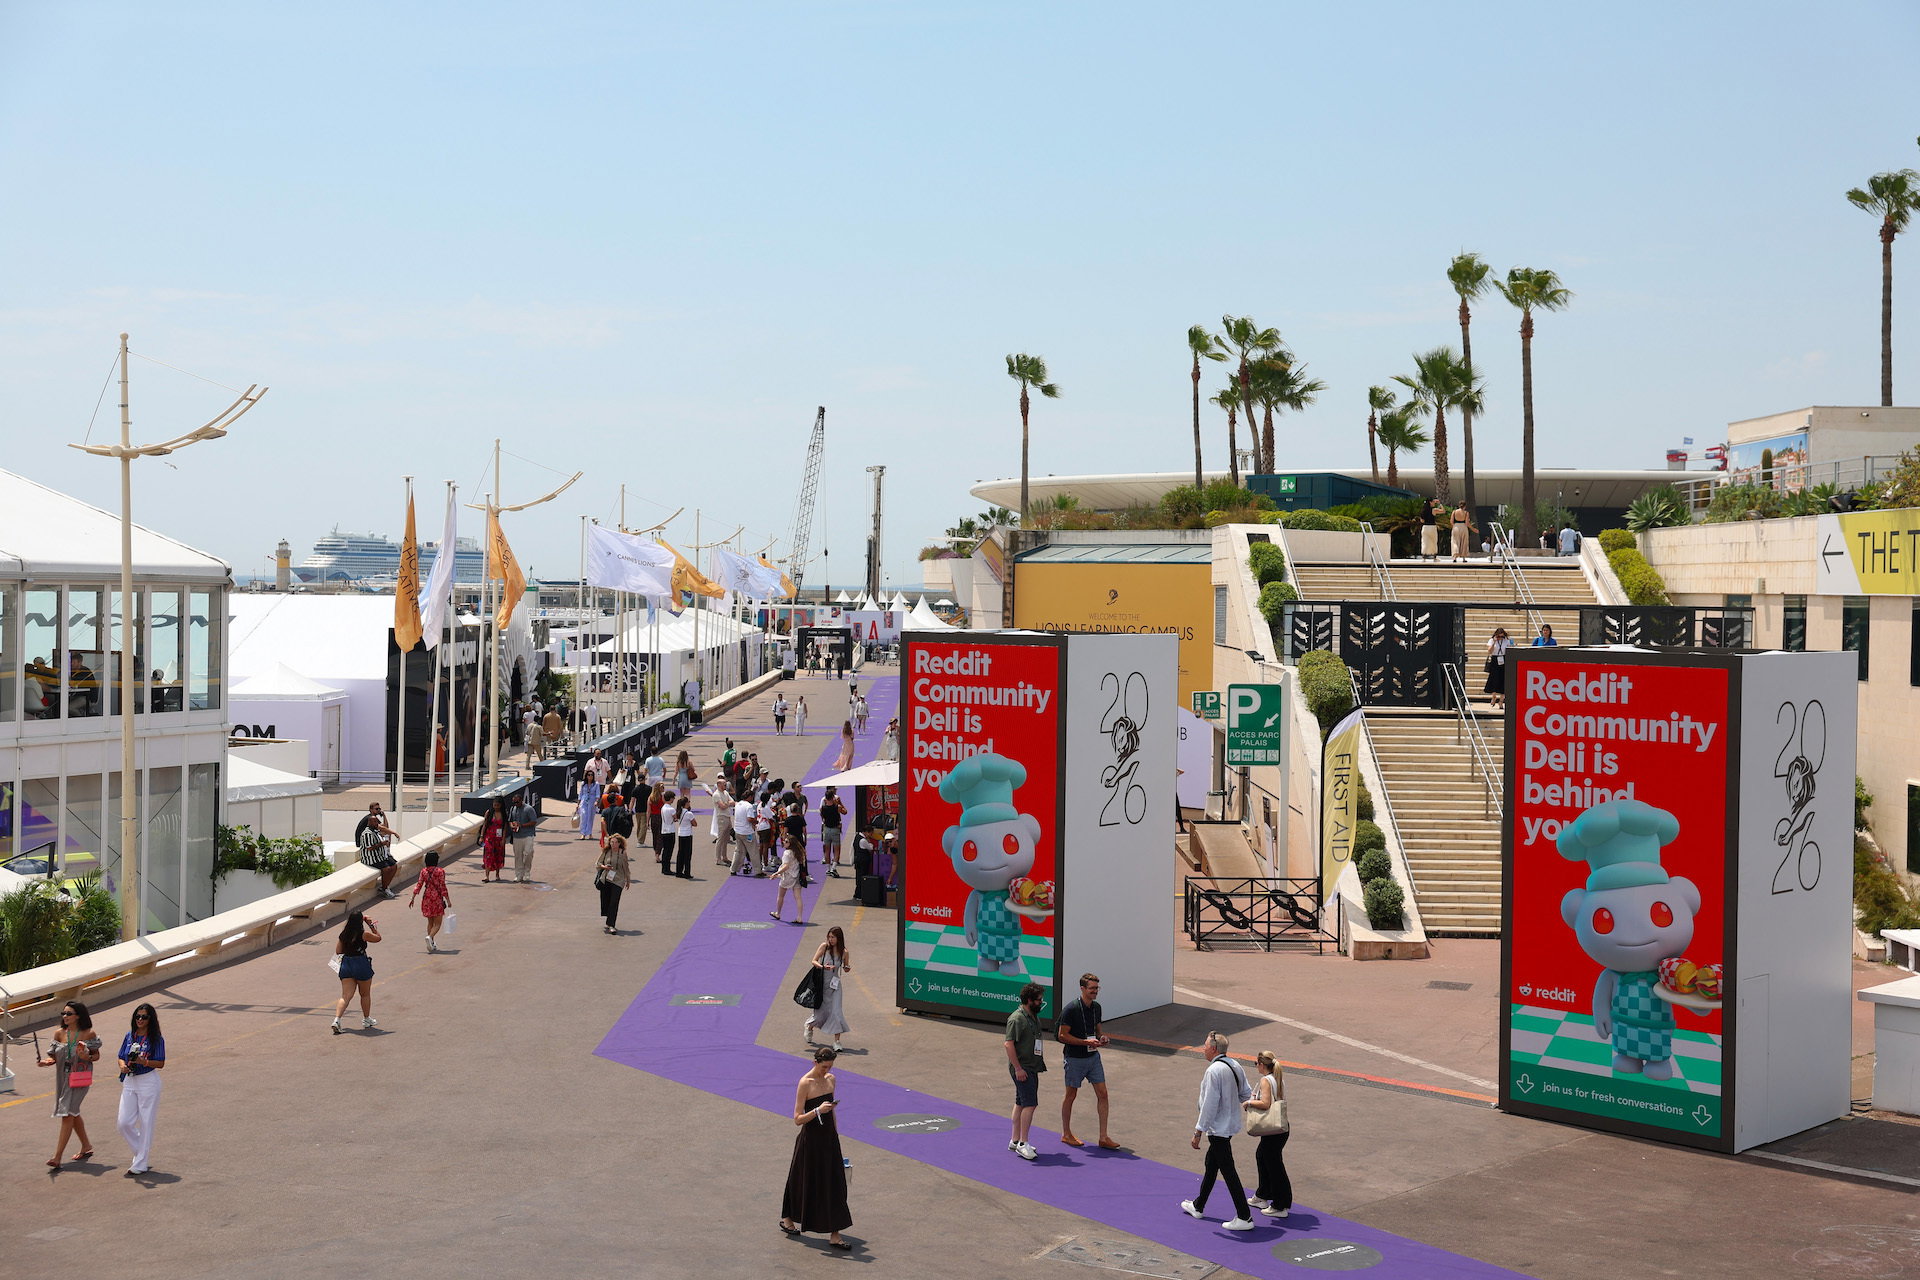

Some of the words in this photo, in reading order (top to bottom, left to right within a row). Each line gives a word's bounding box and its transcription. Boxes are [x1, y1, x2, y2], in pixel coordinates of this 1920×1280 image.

[617, 553, 637, 566] CANNES
[637, 558, 656, 568] LIONS
[1858, 531, 1899, 573] THE
[1119, 613, 1128, 621] TO
[1128, 613, 1140, 621] THE
[915, 649, 992, 676] Reddit
[913, 677, 1051, 714] Community
[1206, 694, 1217, 707] P
[1525, 670, 1633, 704] Reddit
[914, 706, 958, 732] Deli
[964, 707, 982, 733] is
[1229, 688, 1261, 728] P
[1524, 705, 1717, 752] Community
[913, 733, 993, 760] behind
[1524, 740, 1585, 772] Deli
[1593, 743, 1619, 775] is
[1333, 753, 1352, 815] FIRST
[1523, 773, 1635, 808] behind
[1332, 821, 1349, 862] AID
[923, 906, 952, 918] reddit
[928, 982, 941, 992] join
[942, 985, 950, 993] us
[951, 985, 961, 995] for
[962, 987, 980, 997] fresh
[981, 991, 1021, 1003] conversatio
[1536, 986, 1576, 1003] reddit
[1542, 1082, 1561, 1094] join
[1562, 1087, 1573, 1096] us
[1575, 1087, 1589, 1099] for
[1591, 1090, 1615, 1103] fresh
[1616, 1096, 1684, 1116] conversations
